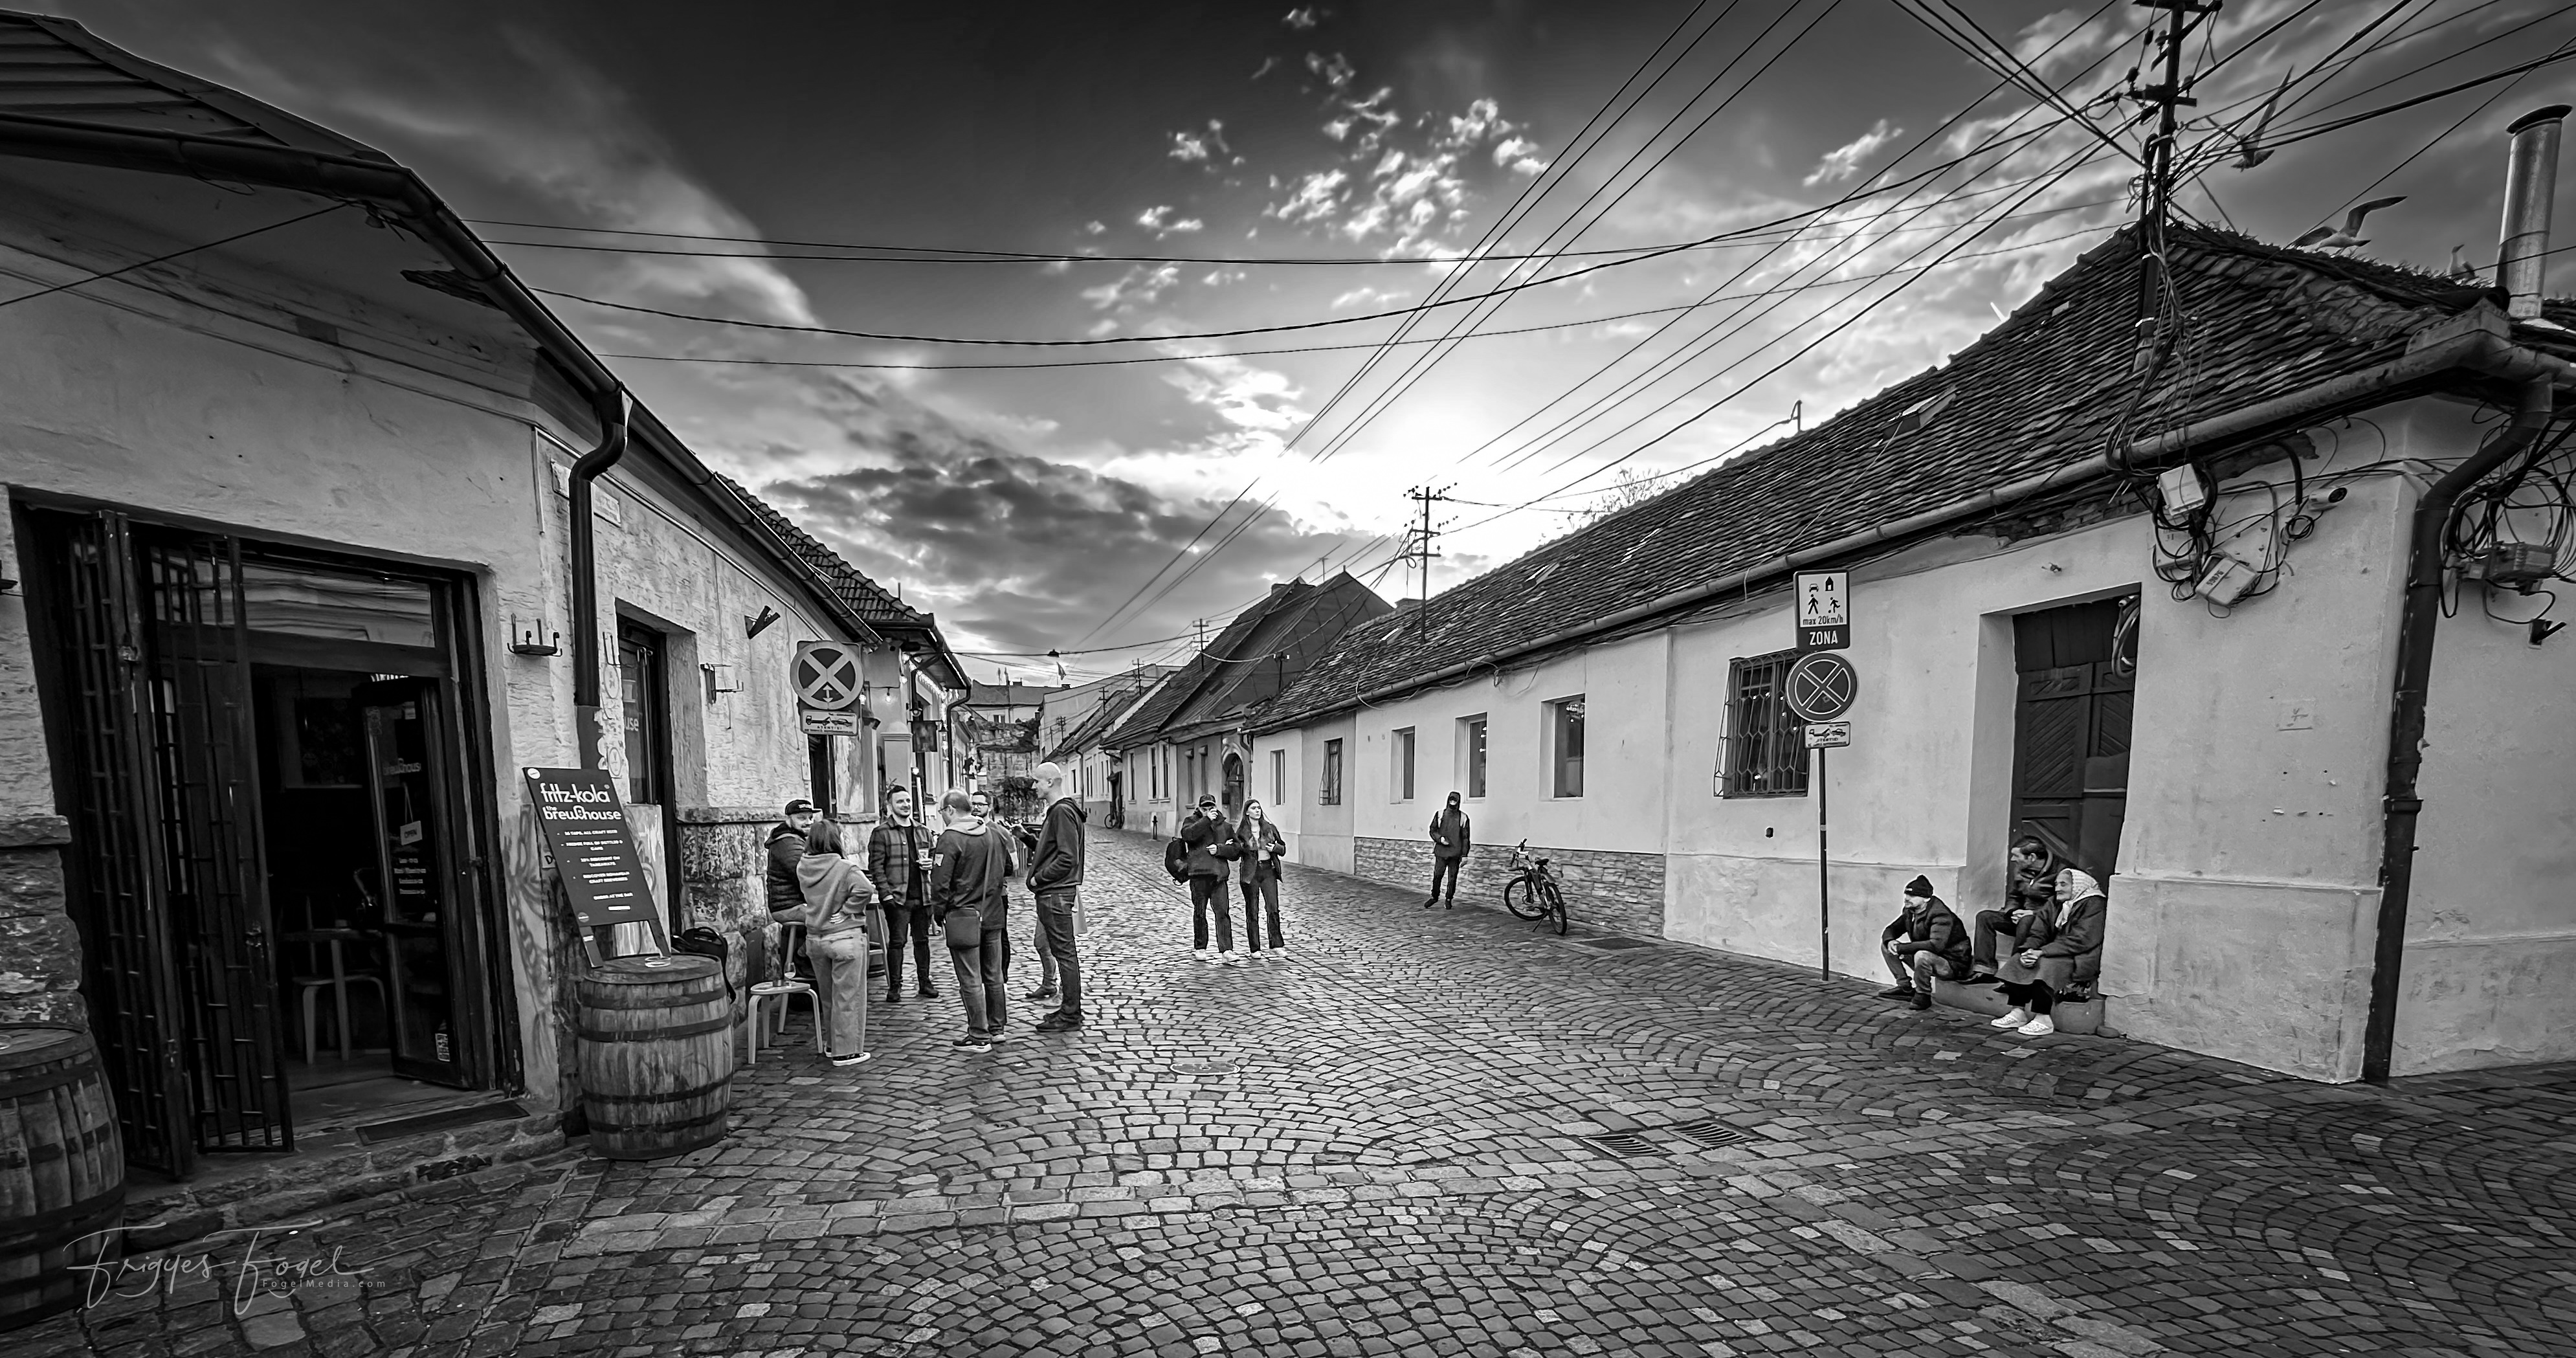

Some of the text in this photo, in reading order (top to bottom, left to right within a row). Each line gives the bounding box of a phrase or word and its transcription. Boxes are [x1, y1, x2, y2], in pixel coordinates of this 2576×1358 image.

[1818, 614, 1843, 625] 20km/h
[1809, 630, 1838, 645] ZONA
[539, 782, 611, 803] fritz-kola
